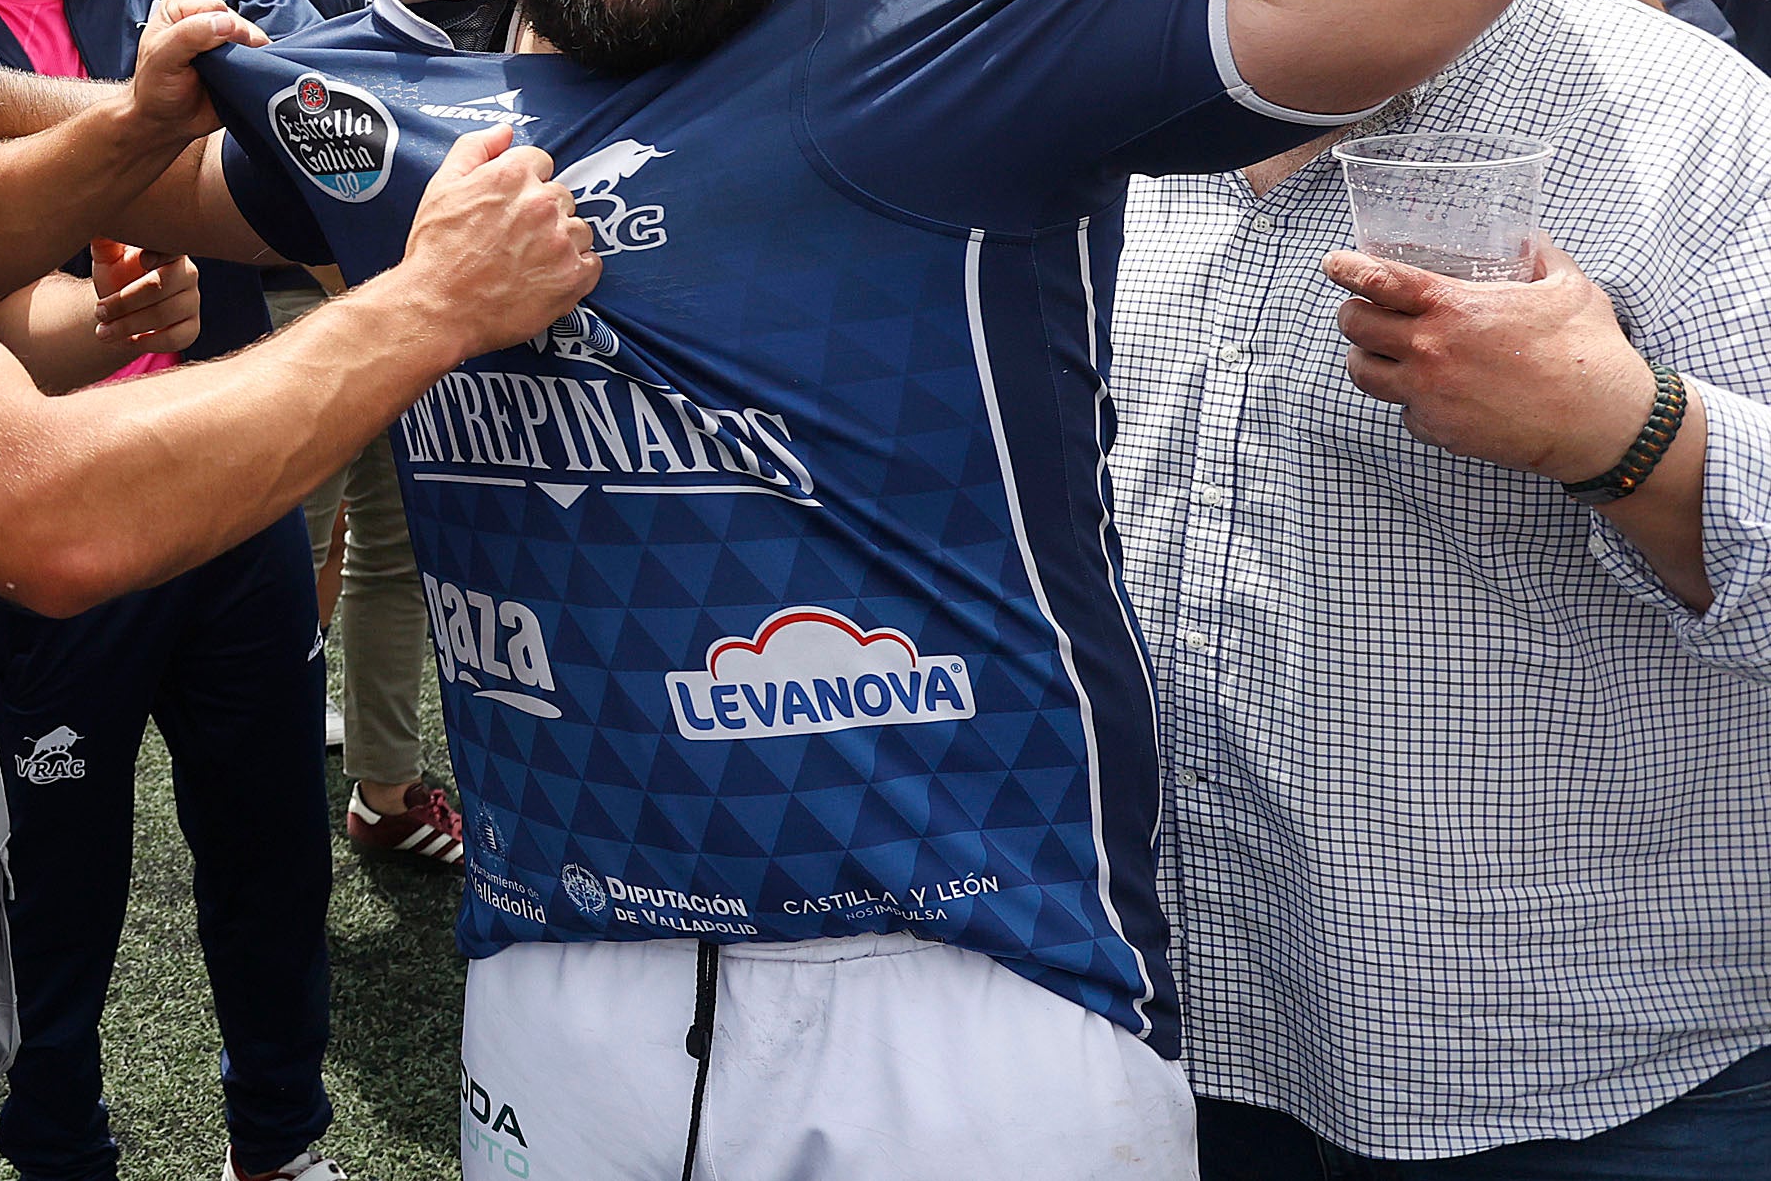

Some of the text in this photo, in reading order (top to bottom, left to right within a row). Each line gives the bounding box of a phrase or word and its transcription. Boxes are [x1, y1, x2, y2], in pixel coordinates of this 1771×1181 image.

[281, 108, 374, 144] Estrella
[419, 104, 540, 127] MERCURY
[299, 140, 376, 173] Galicia
[423, 571, 556, 692] gaza
[675, 665, 966, 731] LEVANOVA
[14, 754, 86, 779] VRAC
[469, 858, 540, 901] Ayuntamiento de
[470, 873, 547, 925] Valladolid
[605, 875, 748, 917] DIPUTACIÓN
[783, 872, 999, 915] CASTILLA Y LEÓN
[641, 909, 759, 935] VALLADOLID
